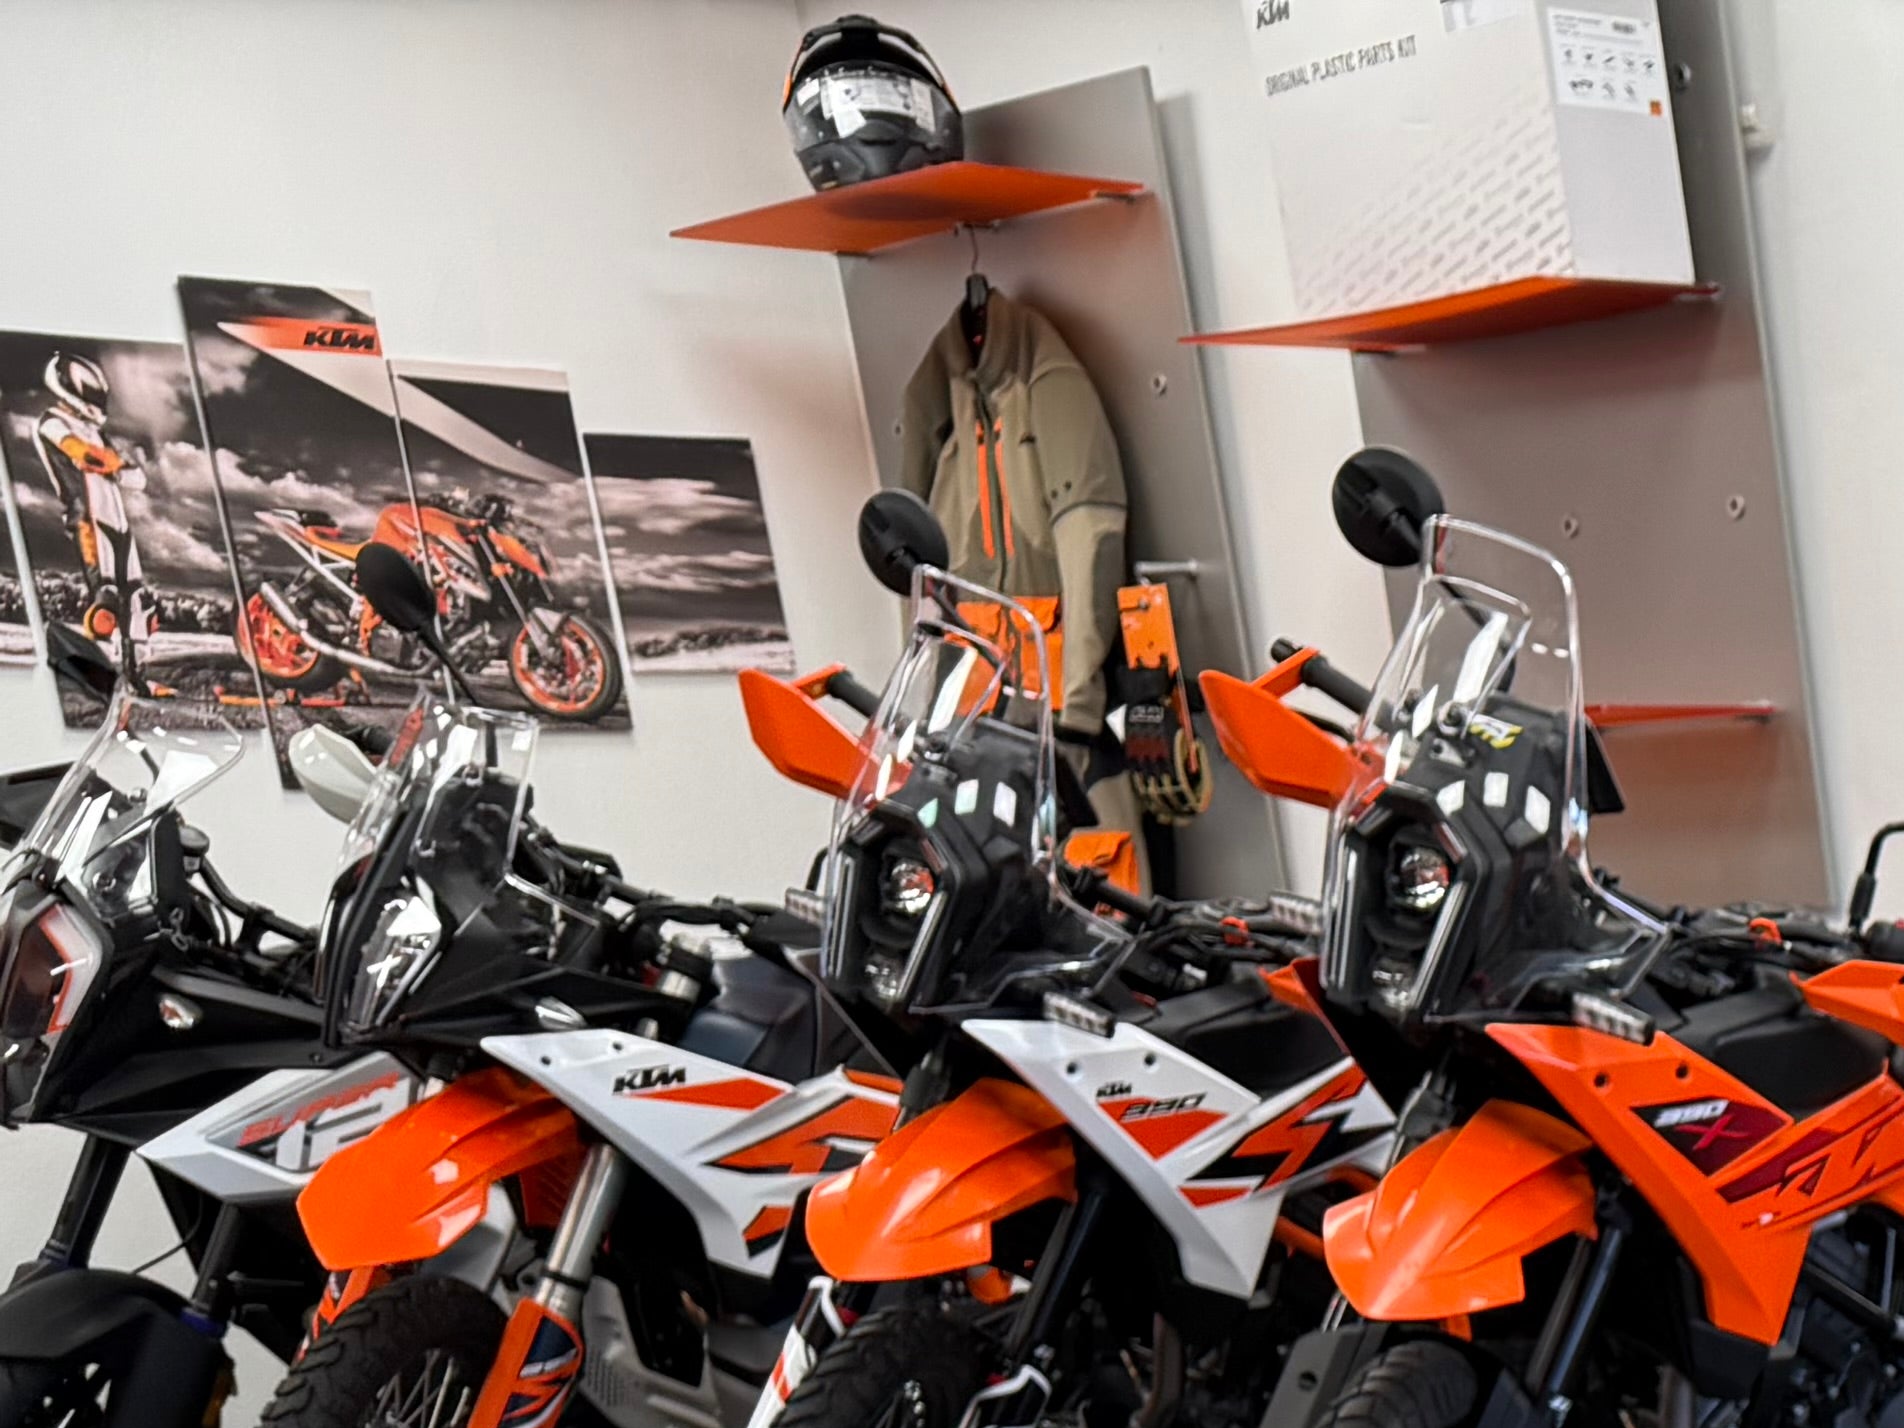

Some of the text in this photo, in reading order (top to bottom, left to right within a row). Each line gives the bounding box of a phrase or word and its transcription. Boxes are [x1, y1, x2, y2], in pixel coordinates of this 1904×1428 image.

[1256, 0, 1291, 29] KTM
[1265, 34, 1417, 97] ORIGINAL PLASTIC PARTS KIT
[304, 327, 376, 350] KTM
[613, 1065, 686, 1093] KTM
[1096, 1081, 1132, 1098] KTM
[1654, 1099, 1729, 1128] 390
